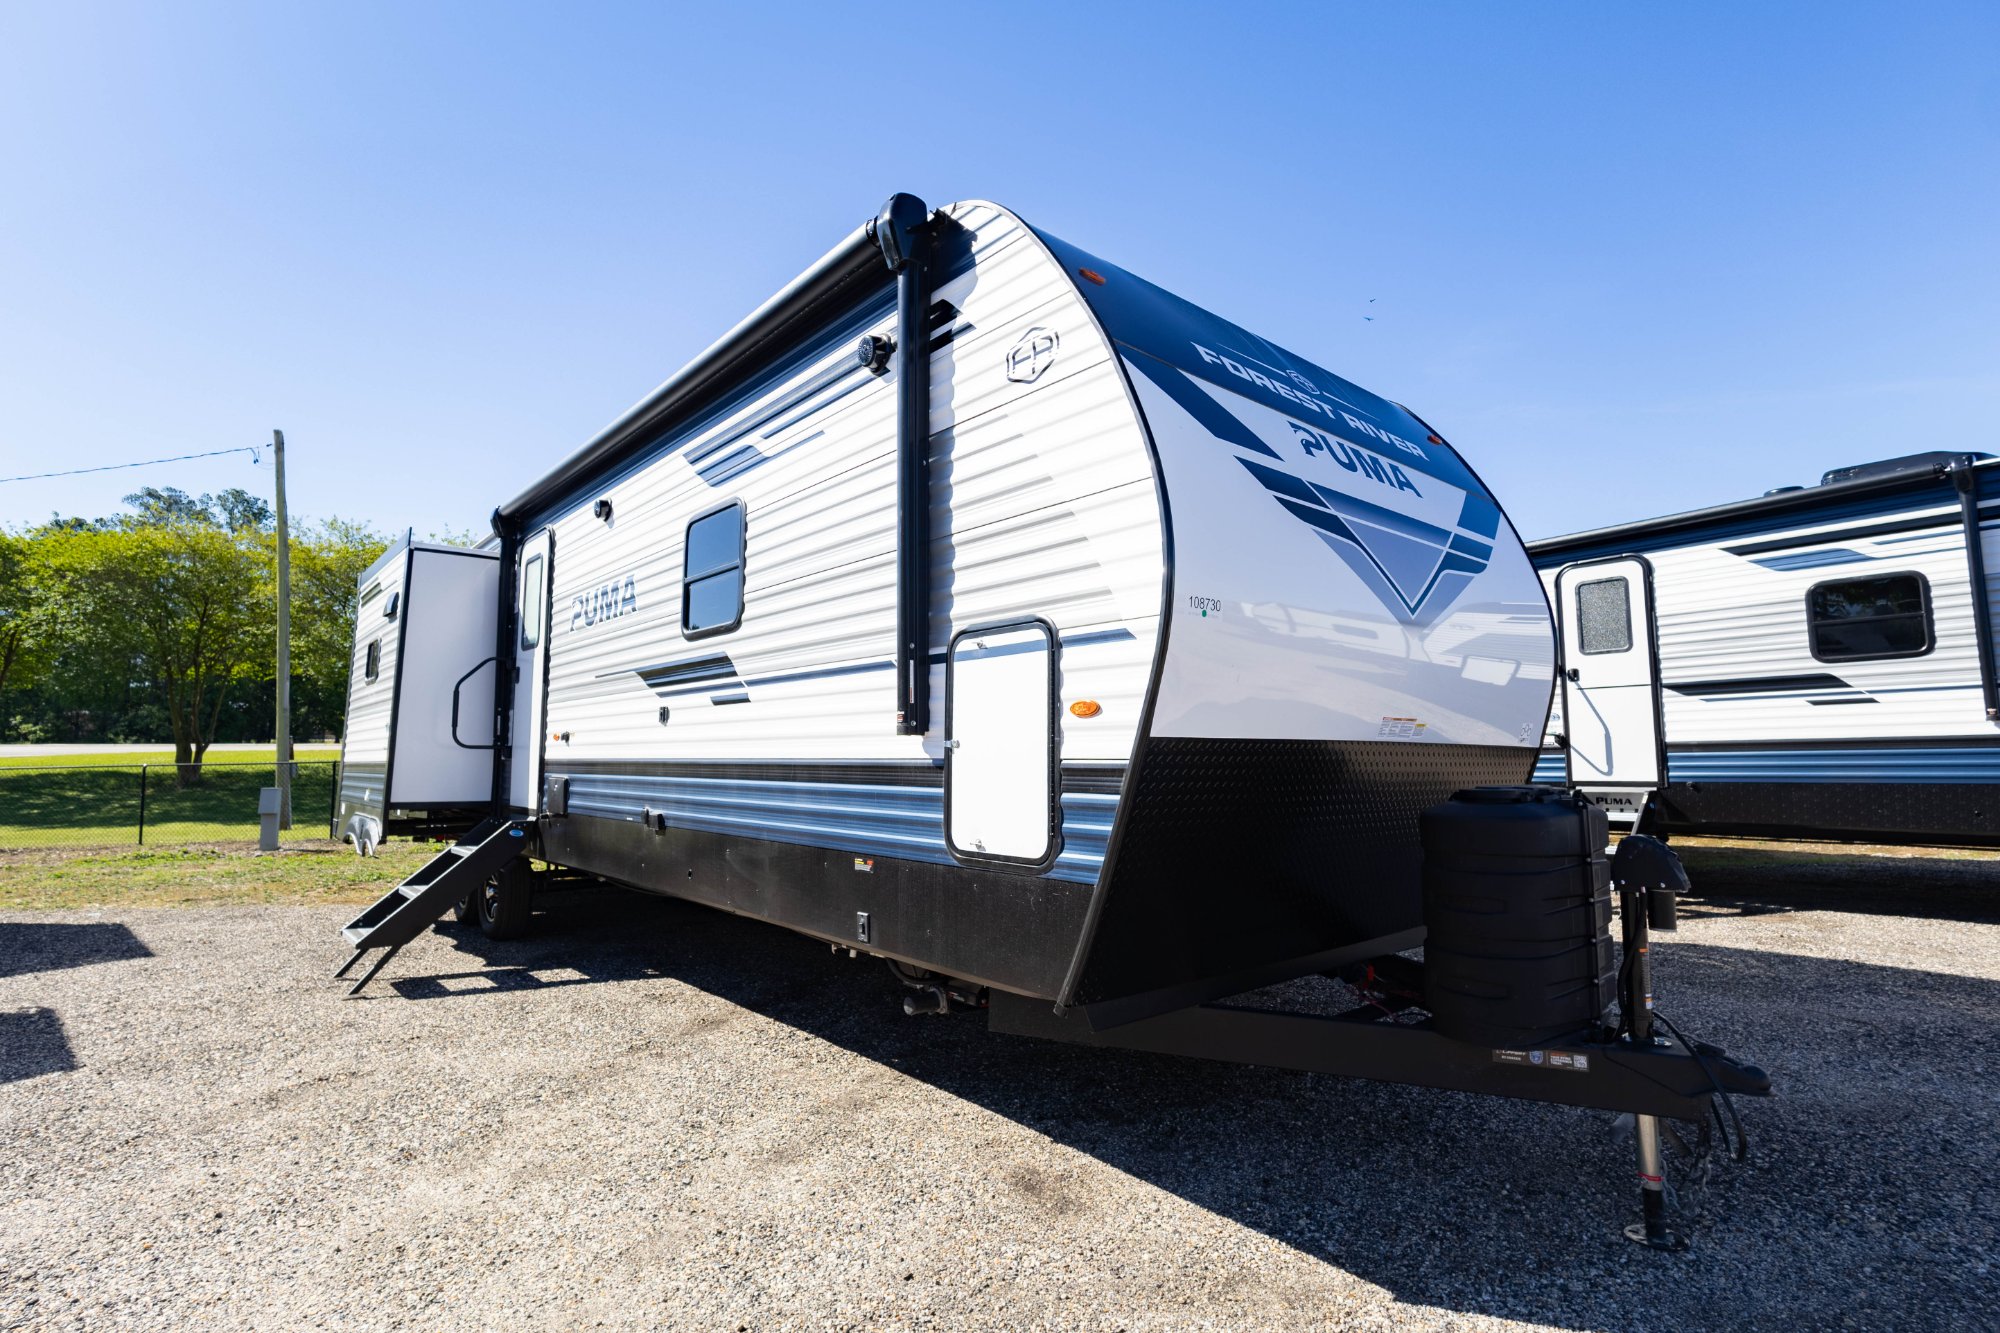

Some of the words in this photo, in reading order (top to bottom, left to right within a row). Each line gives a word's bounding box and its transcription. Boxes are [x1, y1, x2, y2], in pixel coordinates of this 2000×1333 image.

[1190, 341, 1337, 419] FOREST
[1337, 410, 1429, 461] RIVER
[1287, 420, 1423, 499] PUMA
[569, 574, 637, 632] PUMA
[1189, 596, 1222, 612] 108730
[1595, 796, 1633, 806] PUMA
